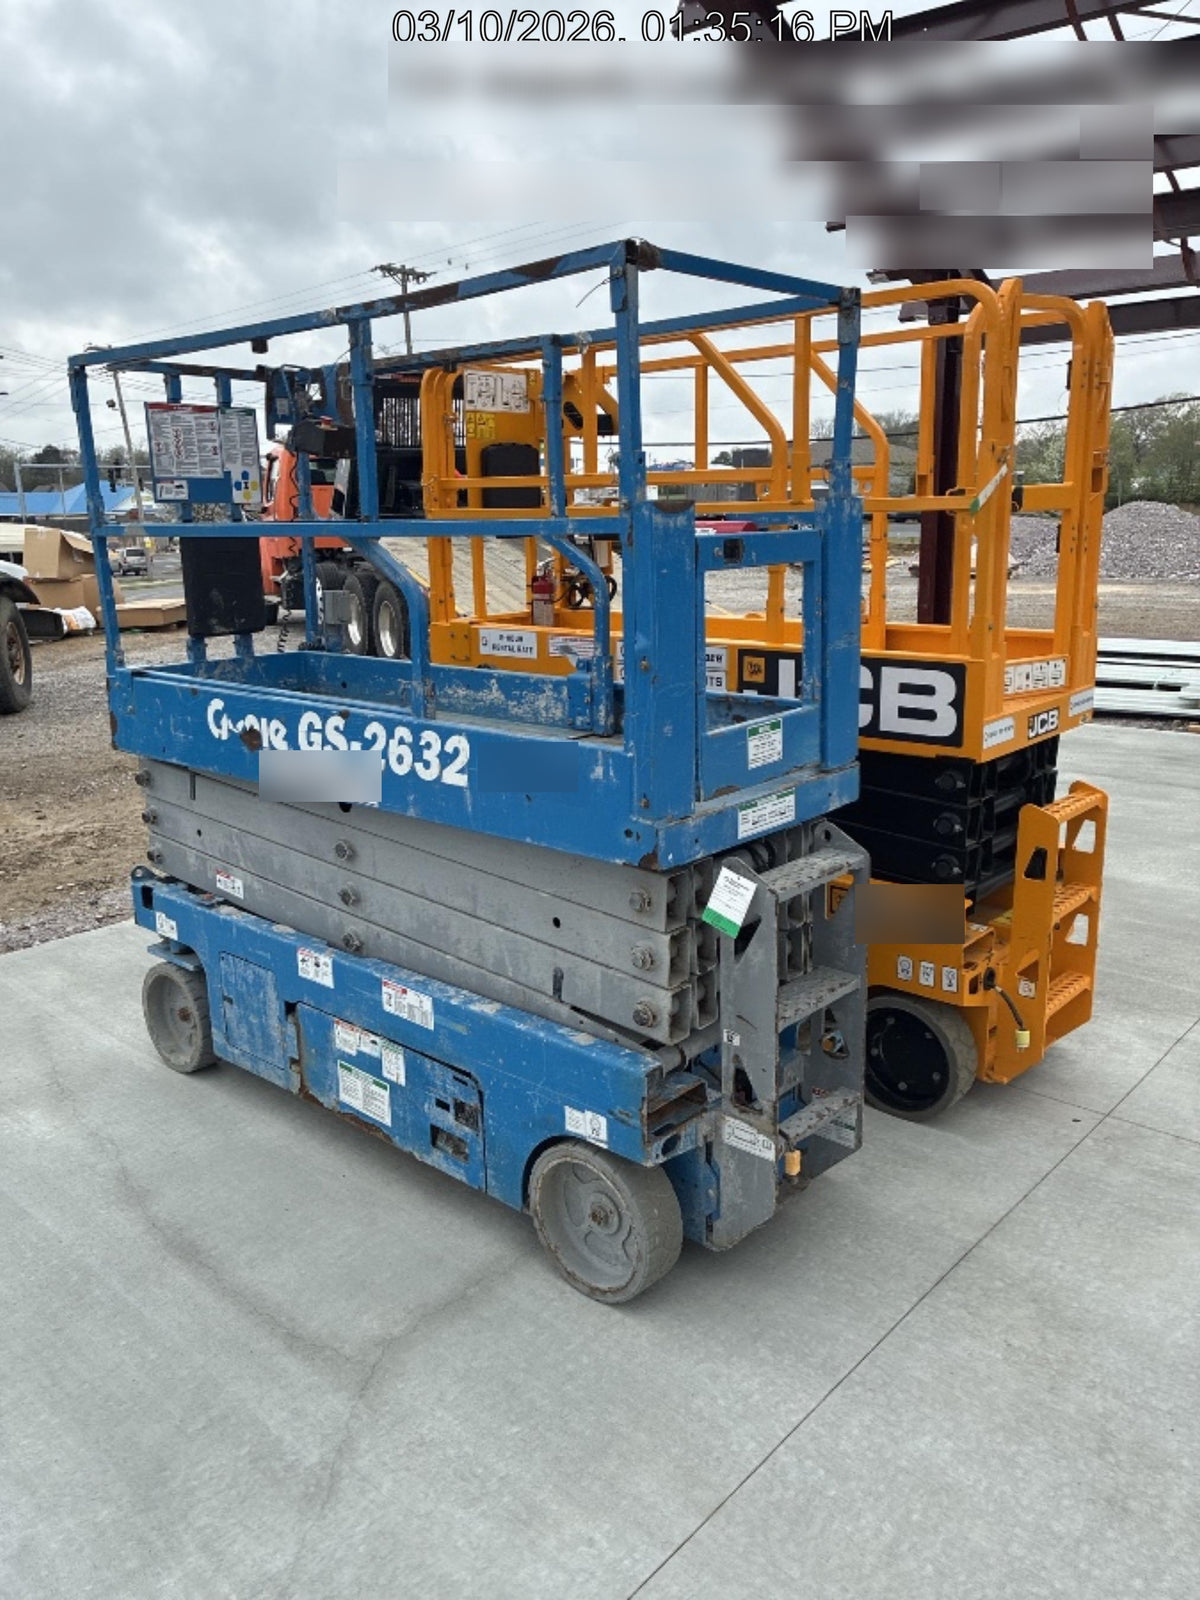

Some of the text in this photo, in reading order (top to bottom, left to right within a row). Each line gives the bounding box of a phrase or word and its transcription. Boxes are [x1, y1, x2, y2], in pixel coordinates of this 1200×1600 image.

[742, 658, 958, 737] JB
[1028, 708, 1059, 739] JCB
[298, 711, 470, 788] GS-2632
